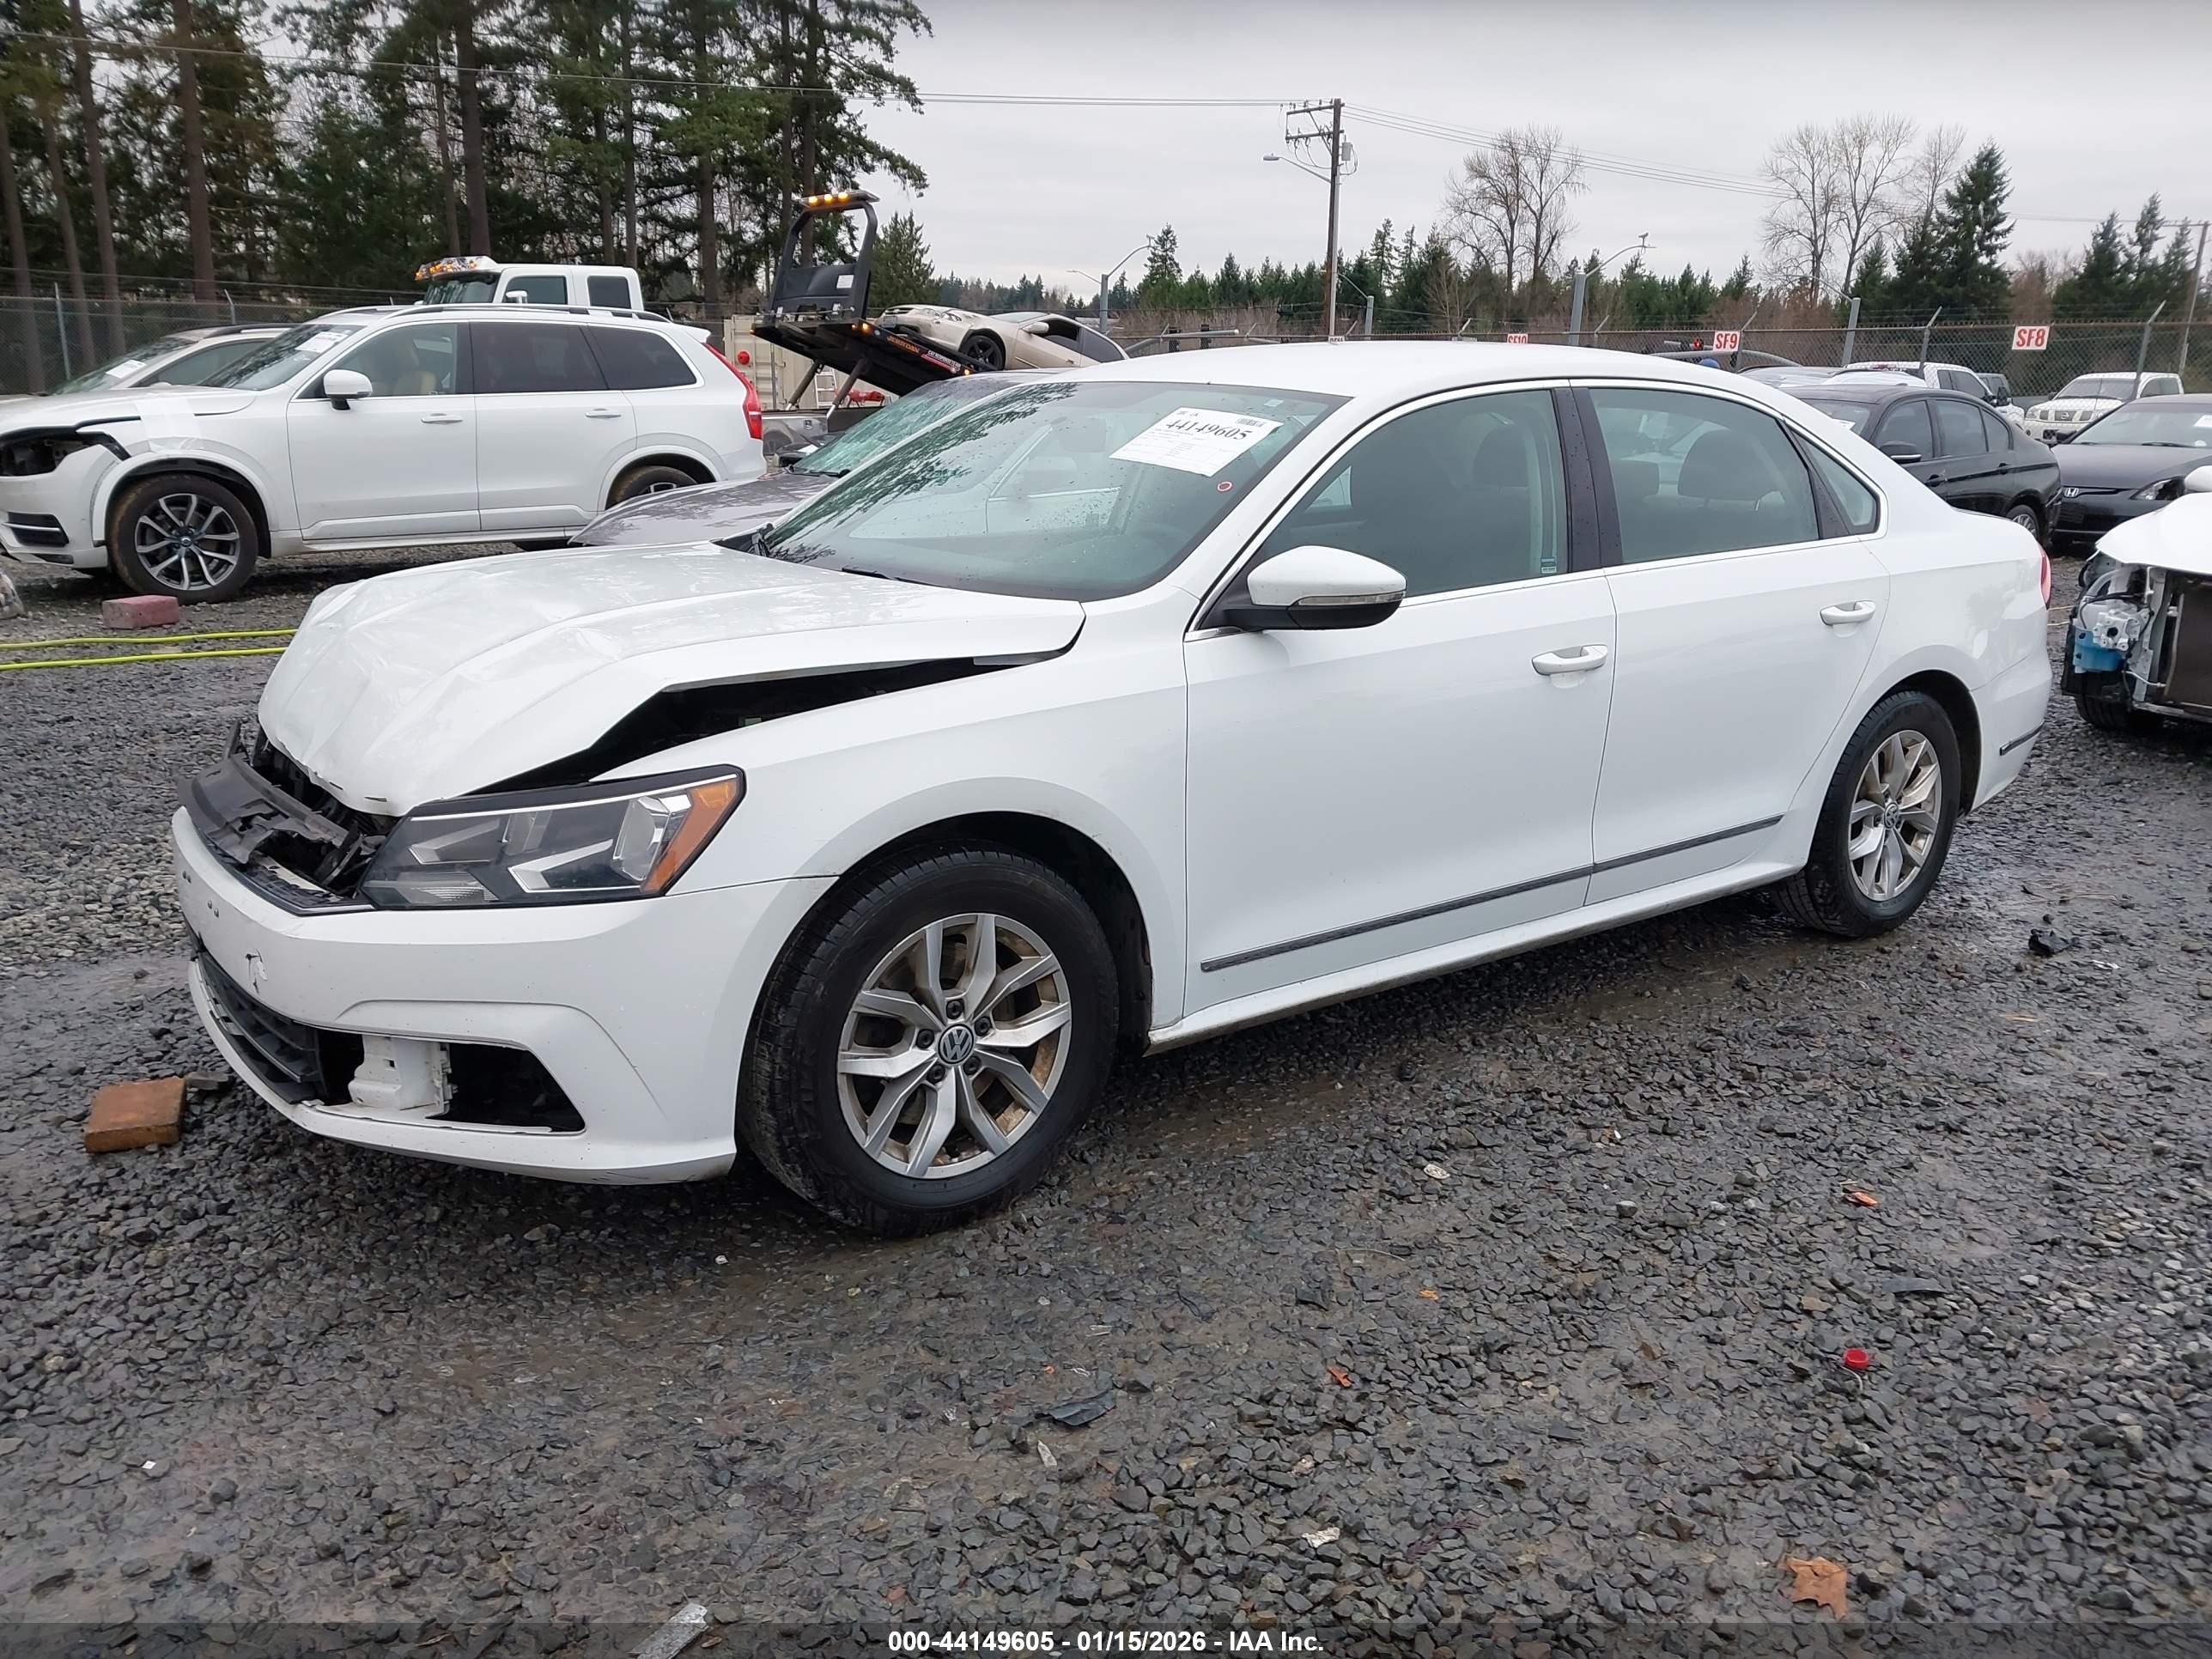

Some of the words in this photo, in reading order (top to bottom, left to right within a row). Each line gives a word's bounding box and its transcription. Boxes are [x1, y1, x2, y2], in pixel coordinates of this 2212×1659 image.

[1715, 332, 1738, 349] SF9
[2016, 328, 2046, 348] SF8
[1165, 419, 1253, 441] 44149605
